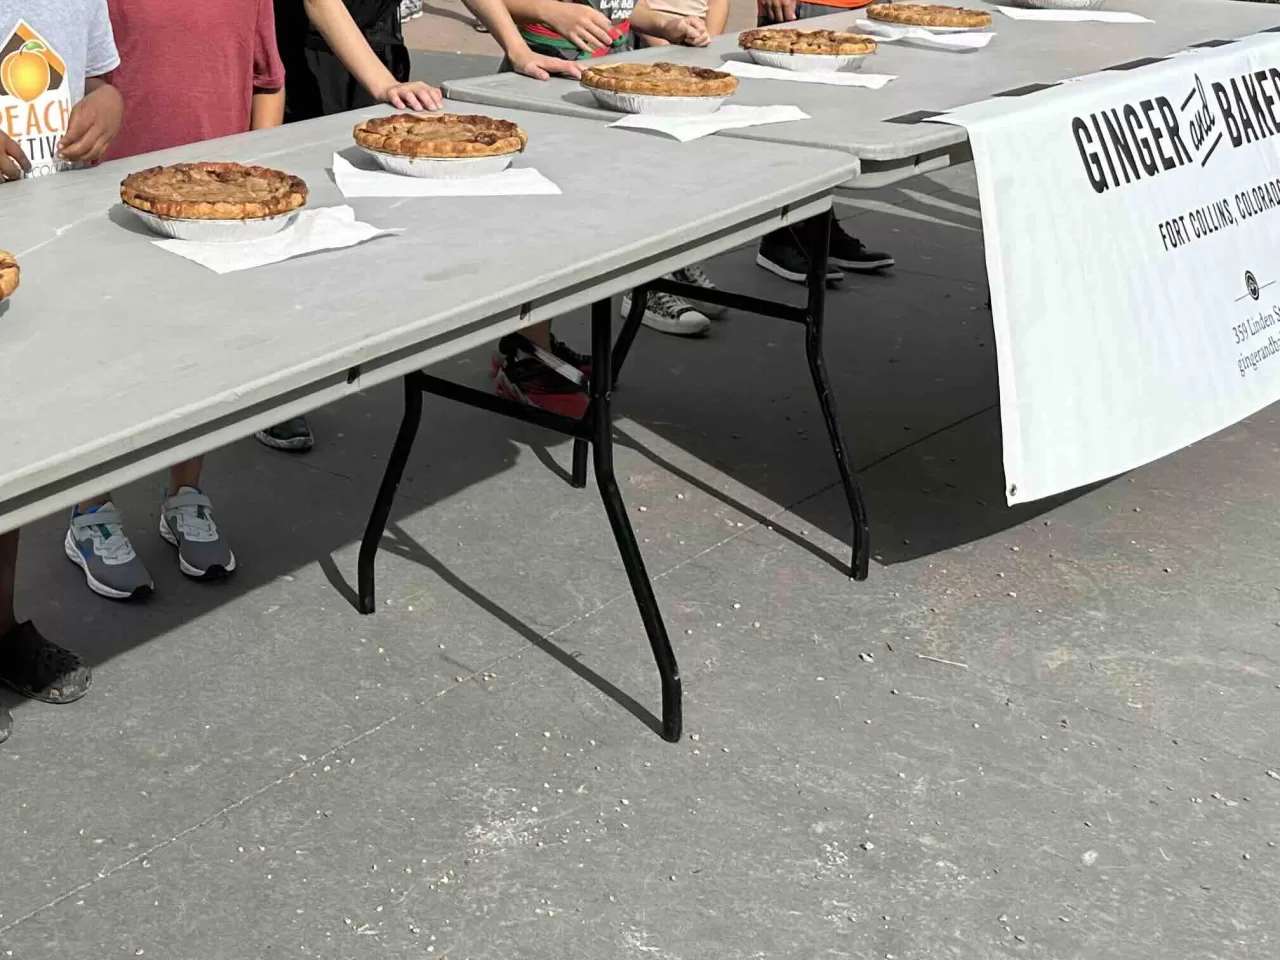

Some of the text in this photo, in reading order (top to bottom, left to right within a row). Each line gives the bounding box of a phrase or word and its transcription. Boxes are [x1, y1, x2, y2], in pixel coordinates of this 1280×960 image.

[1072, 96, 1193, 193] GINGER
[1189, 73, 1216, 151] and
[1158, 215, 1192, 252] FORT
[1189, 198, 1239, 239] COLLINS,
[1232, 324, 1249, 345] 359
[1247, 312, 1276, 336] Linden
